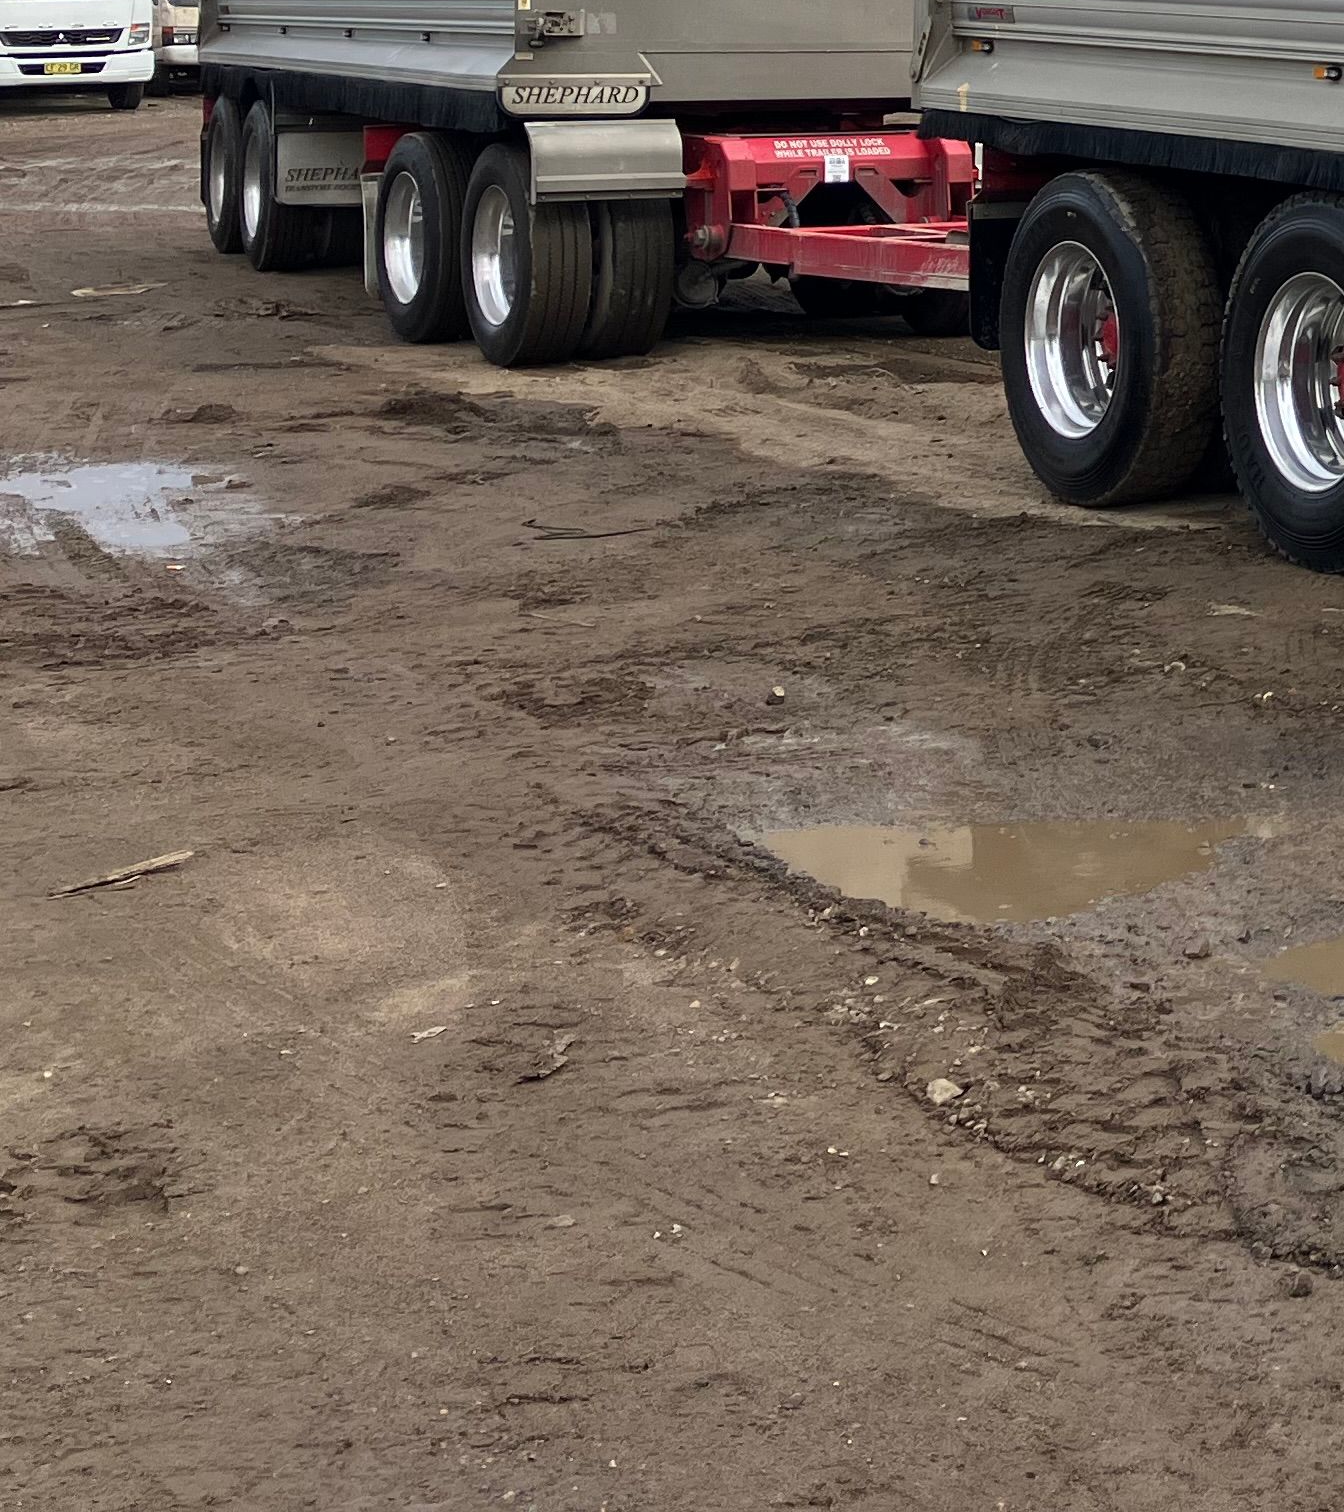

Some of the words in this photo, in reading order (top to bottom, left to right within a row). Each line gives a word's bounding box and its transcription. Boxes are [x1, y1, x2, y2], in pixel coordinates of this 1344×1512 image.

[512, 86, 639, 104] SHEPHARD
[774, 140, 788, 149] DO
[789, 139, 808, 148] NOT
[809, 139, 829, 148] USE
[829, 138, 858, 147] DOLLY
[860, 137, 885, 146] LOCK
[774, 149, 804, 158] WHILE
[805, 148, 842, 157] TRAILER
[845, 148, 854, 156] IS
[855, 147, 891, 156] LOADED
